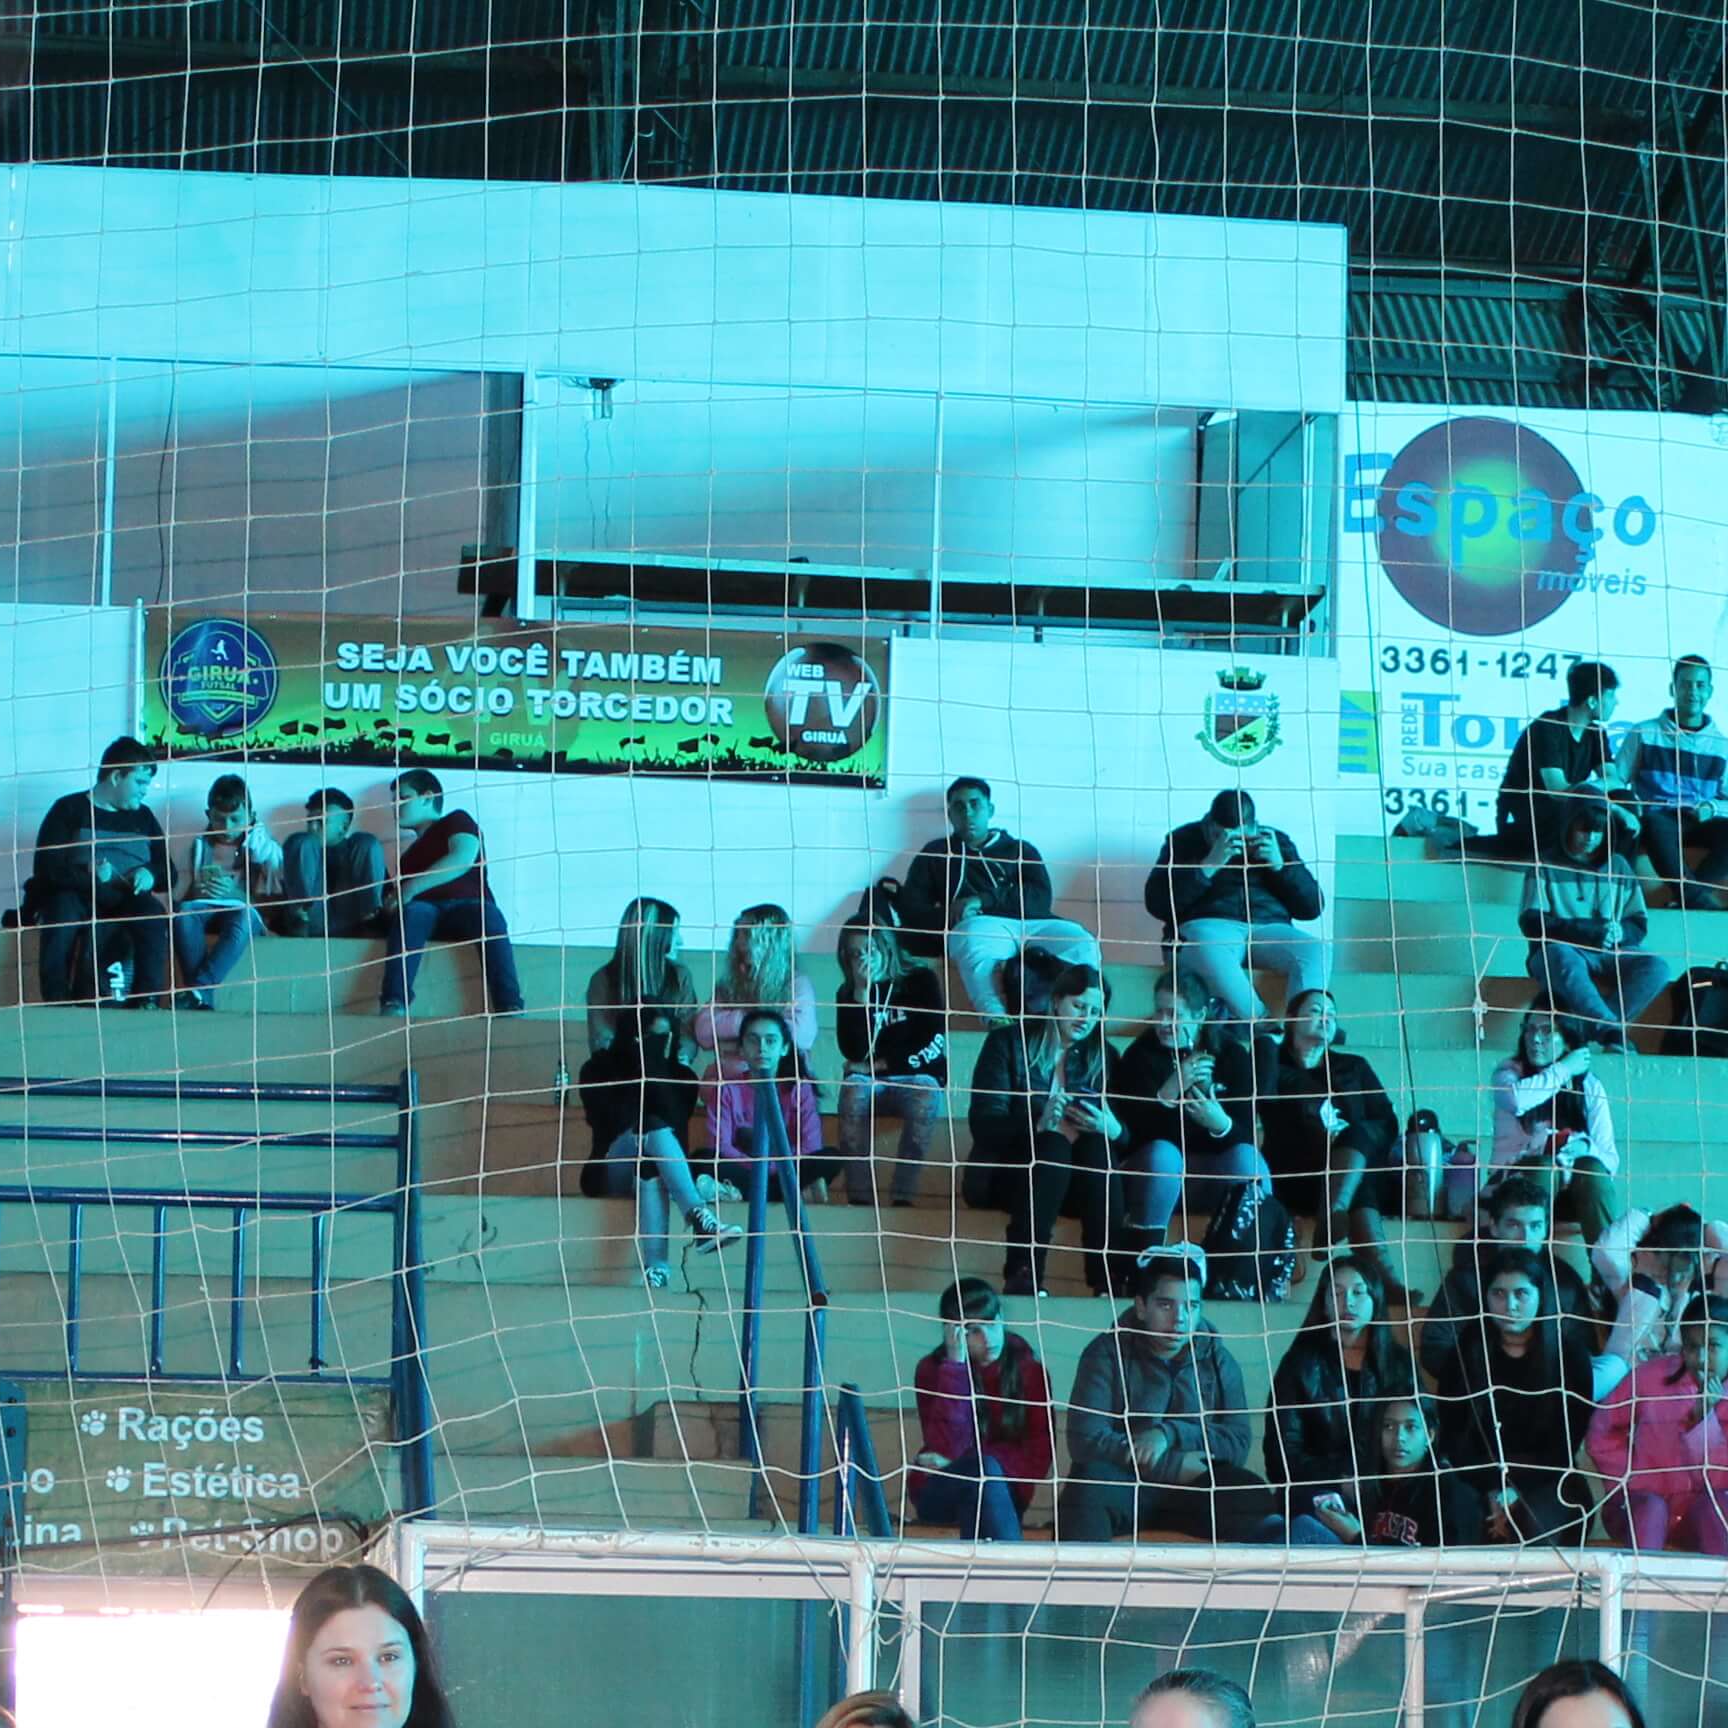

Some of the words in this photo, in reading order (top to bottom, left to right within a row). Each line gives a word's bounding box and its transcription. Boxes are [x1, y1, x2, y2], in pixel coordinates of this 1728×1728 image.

[1343, 453, 1657, 573] Espaço
[337, 642, 434, 674] SEJA
[444, 643, 550, 677] VOCÊ
[561, 649, 722, 685] TAMBÉM
[785, 662, 825, 679] WEB
[323, 682, 382, 712] UM
[395, 677, 515, 716] SÓCIO
[527, 687, 734, 726] TORCEDOR
[783, 680, 873, 728] TV
[489, 731, 547, 748] GIRUÁ
[802, 729, 848, 745] GIRUÁ
[1401, 702, 1418, 746] REDE
[1402, 756, 1448, 777] Sua
[1456, 761, 1506, 780] cas
[118, 1406, 264, 1450] Rações
[142, 1461, 301, 1499] Estética
